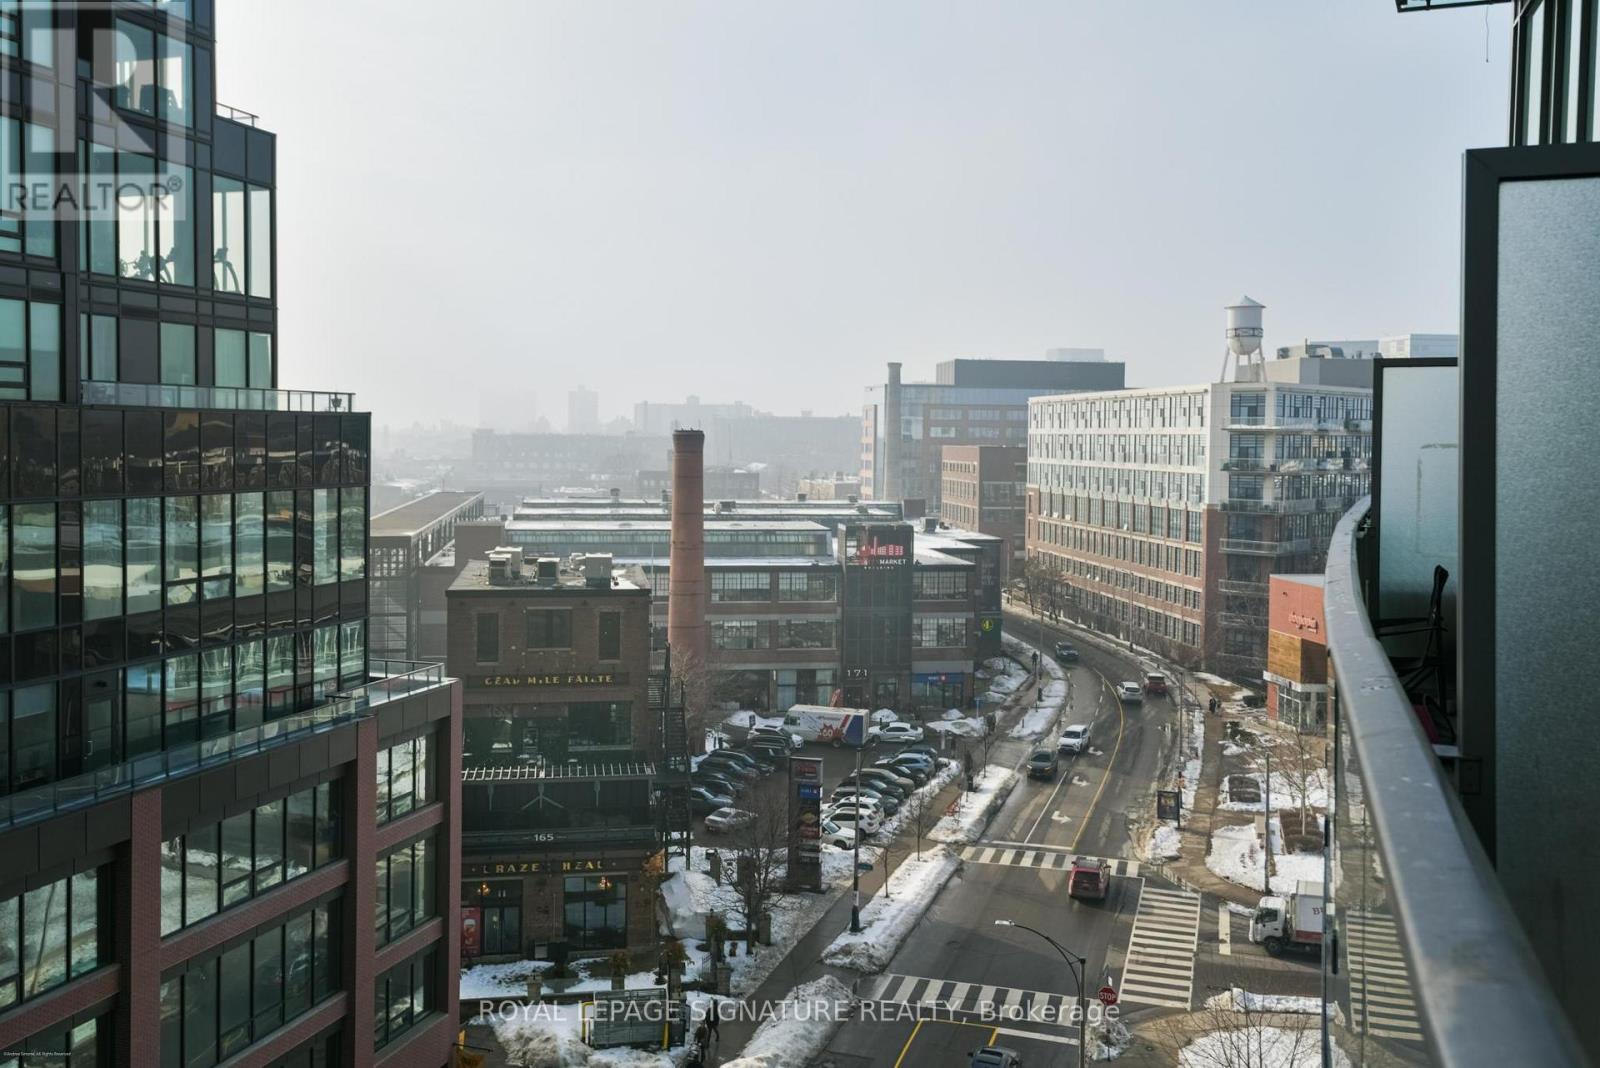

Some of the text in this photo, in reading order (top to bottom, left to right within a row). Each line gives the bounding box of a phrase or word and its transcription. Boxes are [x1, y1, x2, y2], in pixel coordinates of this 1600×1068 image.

[879, 558, 907, 566] MARKET
[847, 669, 868, 677] 171
[533, 833, 555, 842] 165
[1099, 992, 1117, 1001] STOP
